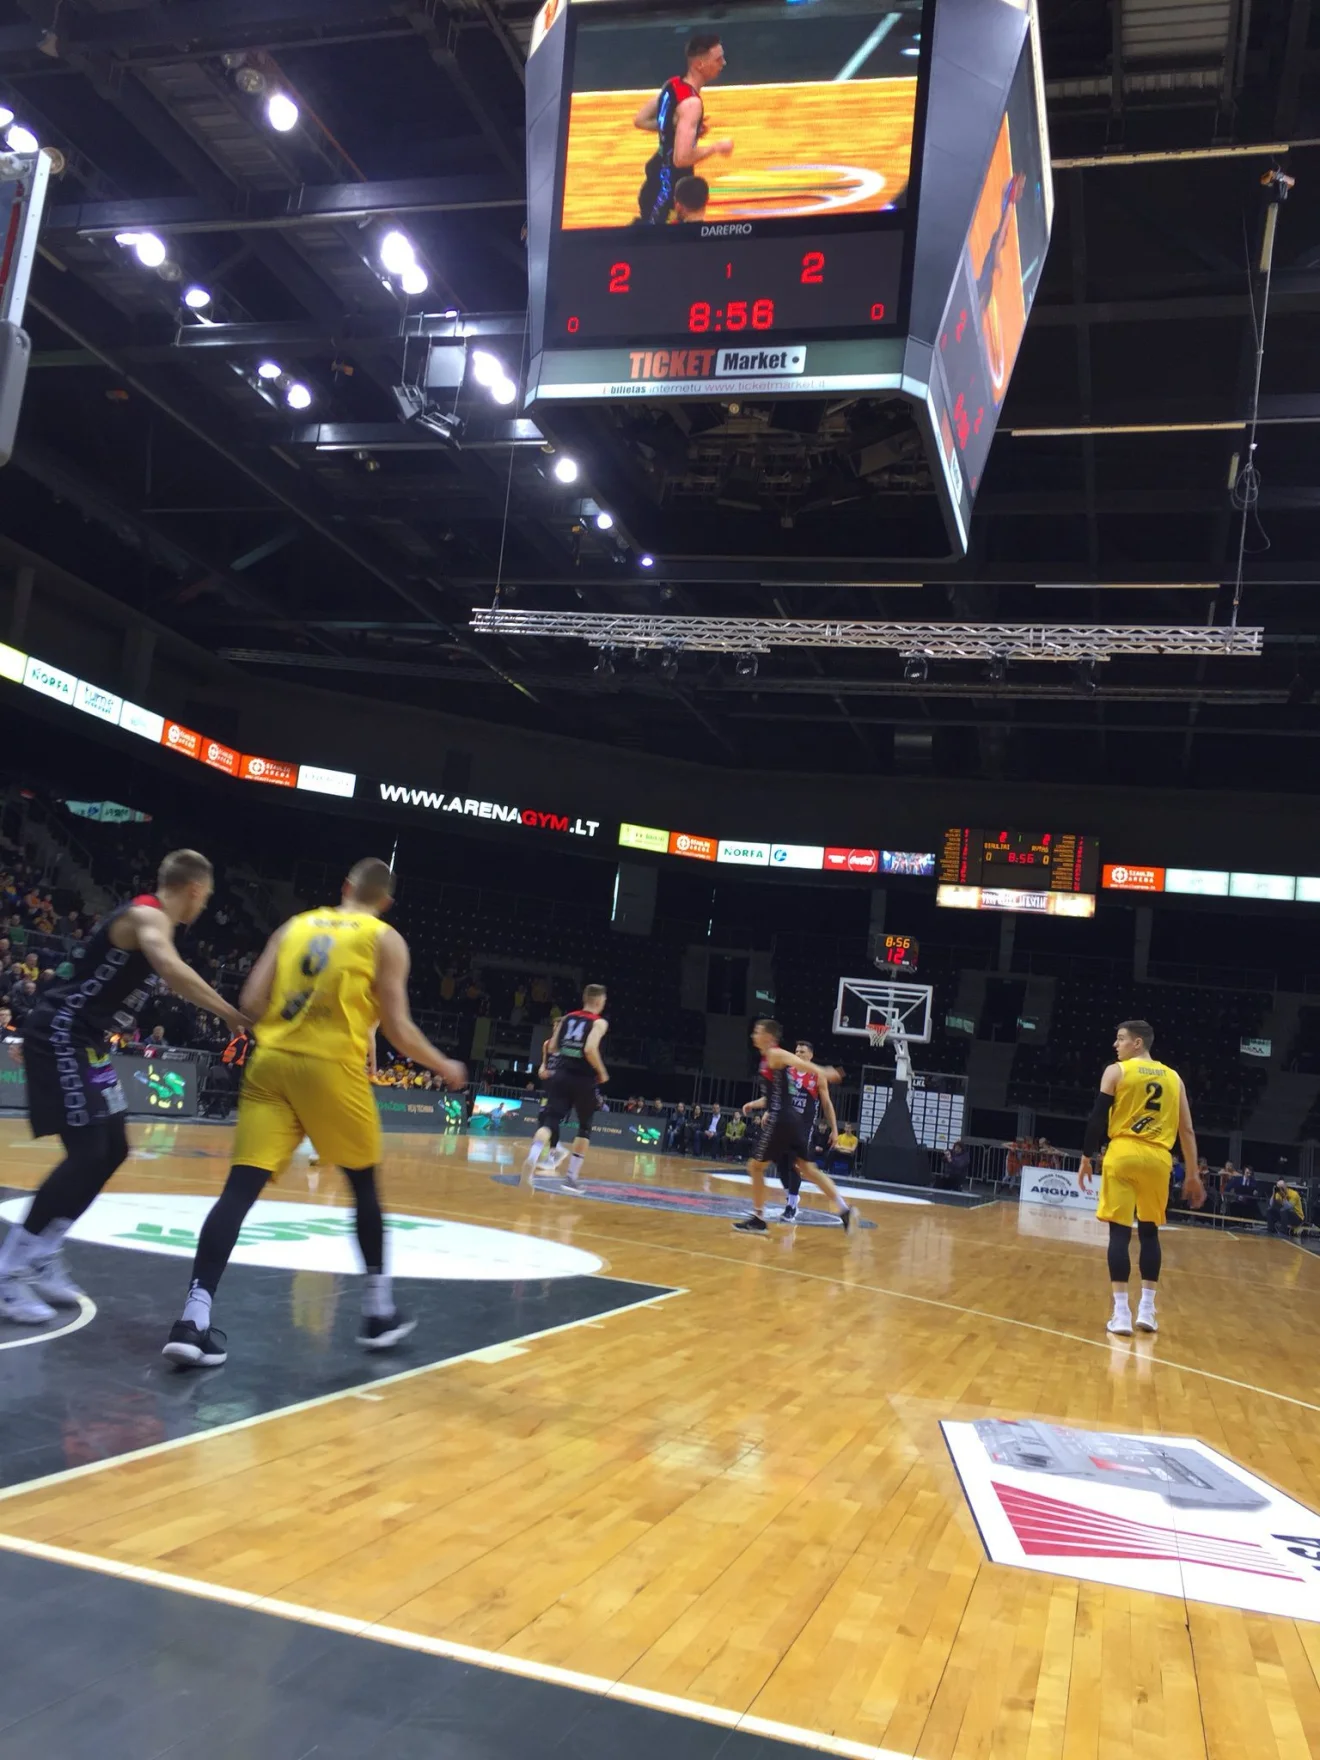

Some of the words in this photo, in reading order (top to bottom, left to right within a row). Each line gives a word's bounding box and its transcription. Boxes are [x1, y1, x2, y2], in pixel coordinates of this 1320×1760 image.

[700, 223, 752, 238] DAREPRO
[725, 262, 733, 280] 1
[800, 252, 826, 284] 2
[608, 262, 632, 294] 2
[688, 298, 775, 333] 8:56
[870, 303, 885, 321] 0
[566, 316, 579, 333] 0
[629, 348, 716, 379] TICKET
[722, 350, 788, 373] Market
[31, 668, 69, 694] NORFA
[379, 783, 600, 837] WWW.ARENAGYM.LT
[723, 846, 764, 859] NORFA
[1007, 852, 1035, 864] 8:56
[885, 936, 910, 949] 8:56
[887, 948, 905, 965] 12
[563, 1018, 587, 1042] 14
[1144, 1081, 1163, 1112] 2
[1030, 1185, 1080, 1198] ARGUS
